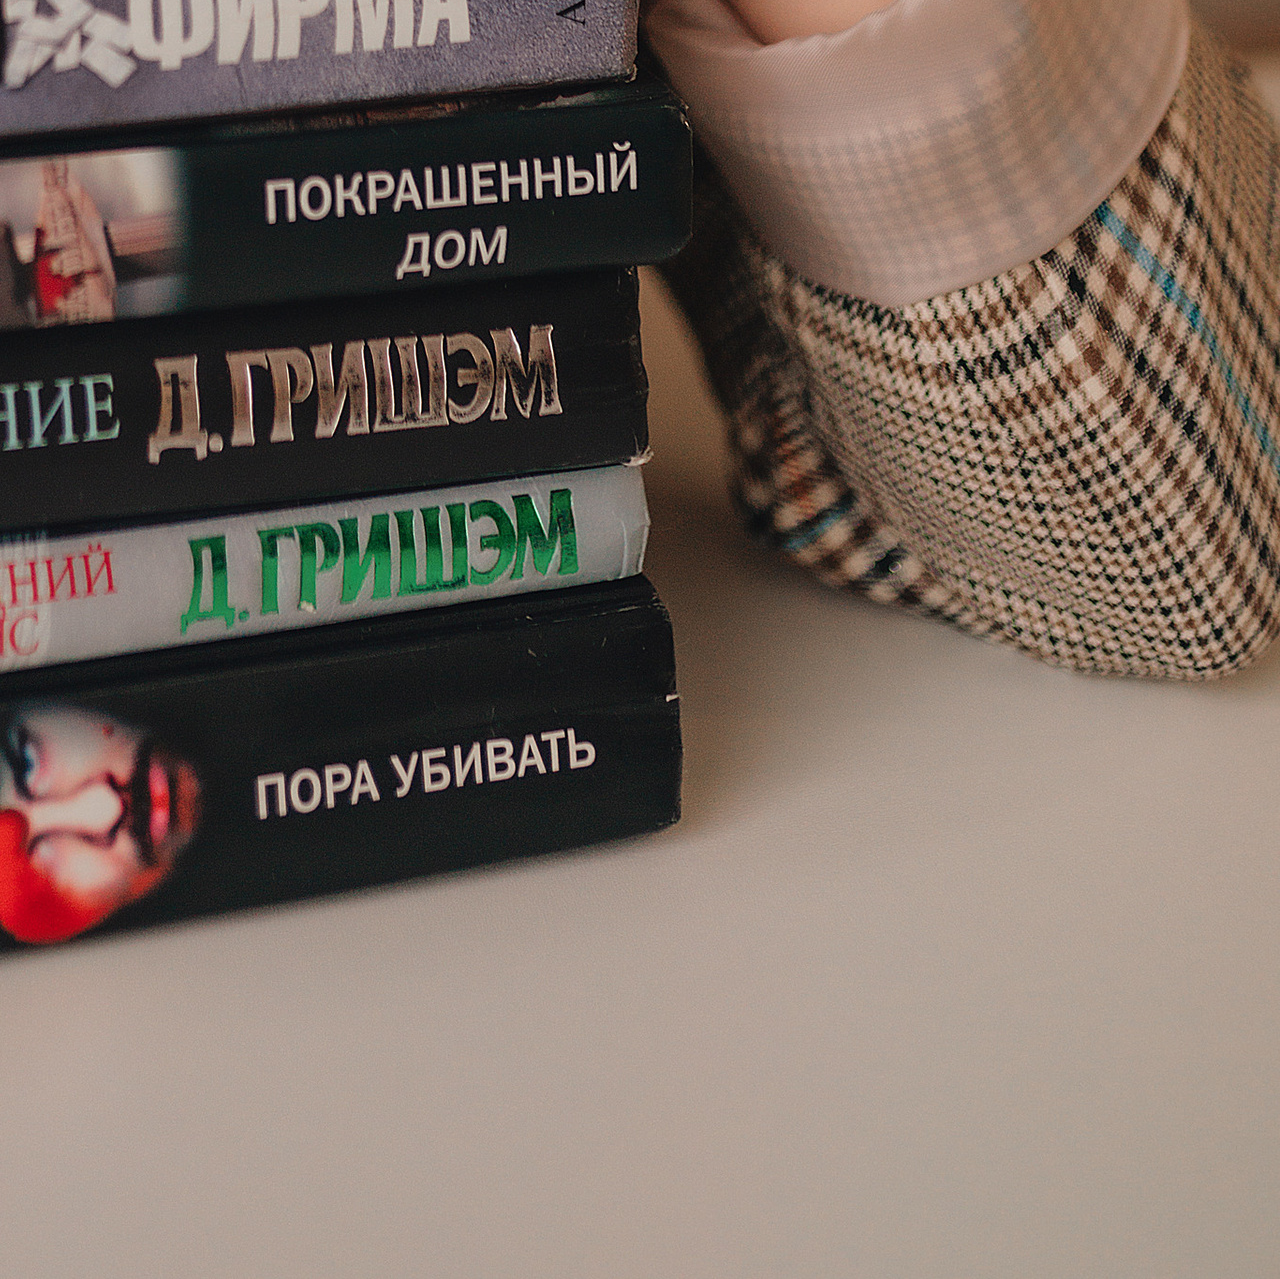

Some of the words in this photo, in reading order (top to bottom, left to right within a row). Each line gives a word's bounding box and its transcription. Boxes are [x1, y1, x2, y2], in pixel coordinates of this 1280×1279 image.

[264, 142, 639, 224] ПОКРАШЕННЫЙ
[396, 226, 509, 280] ДОМ
[256, 759, 380, 821] ПОРА
[391, 727, 597, 799] УБИВАТЬ
